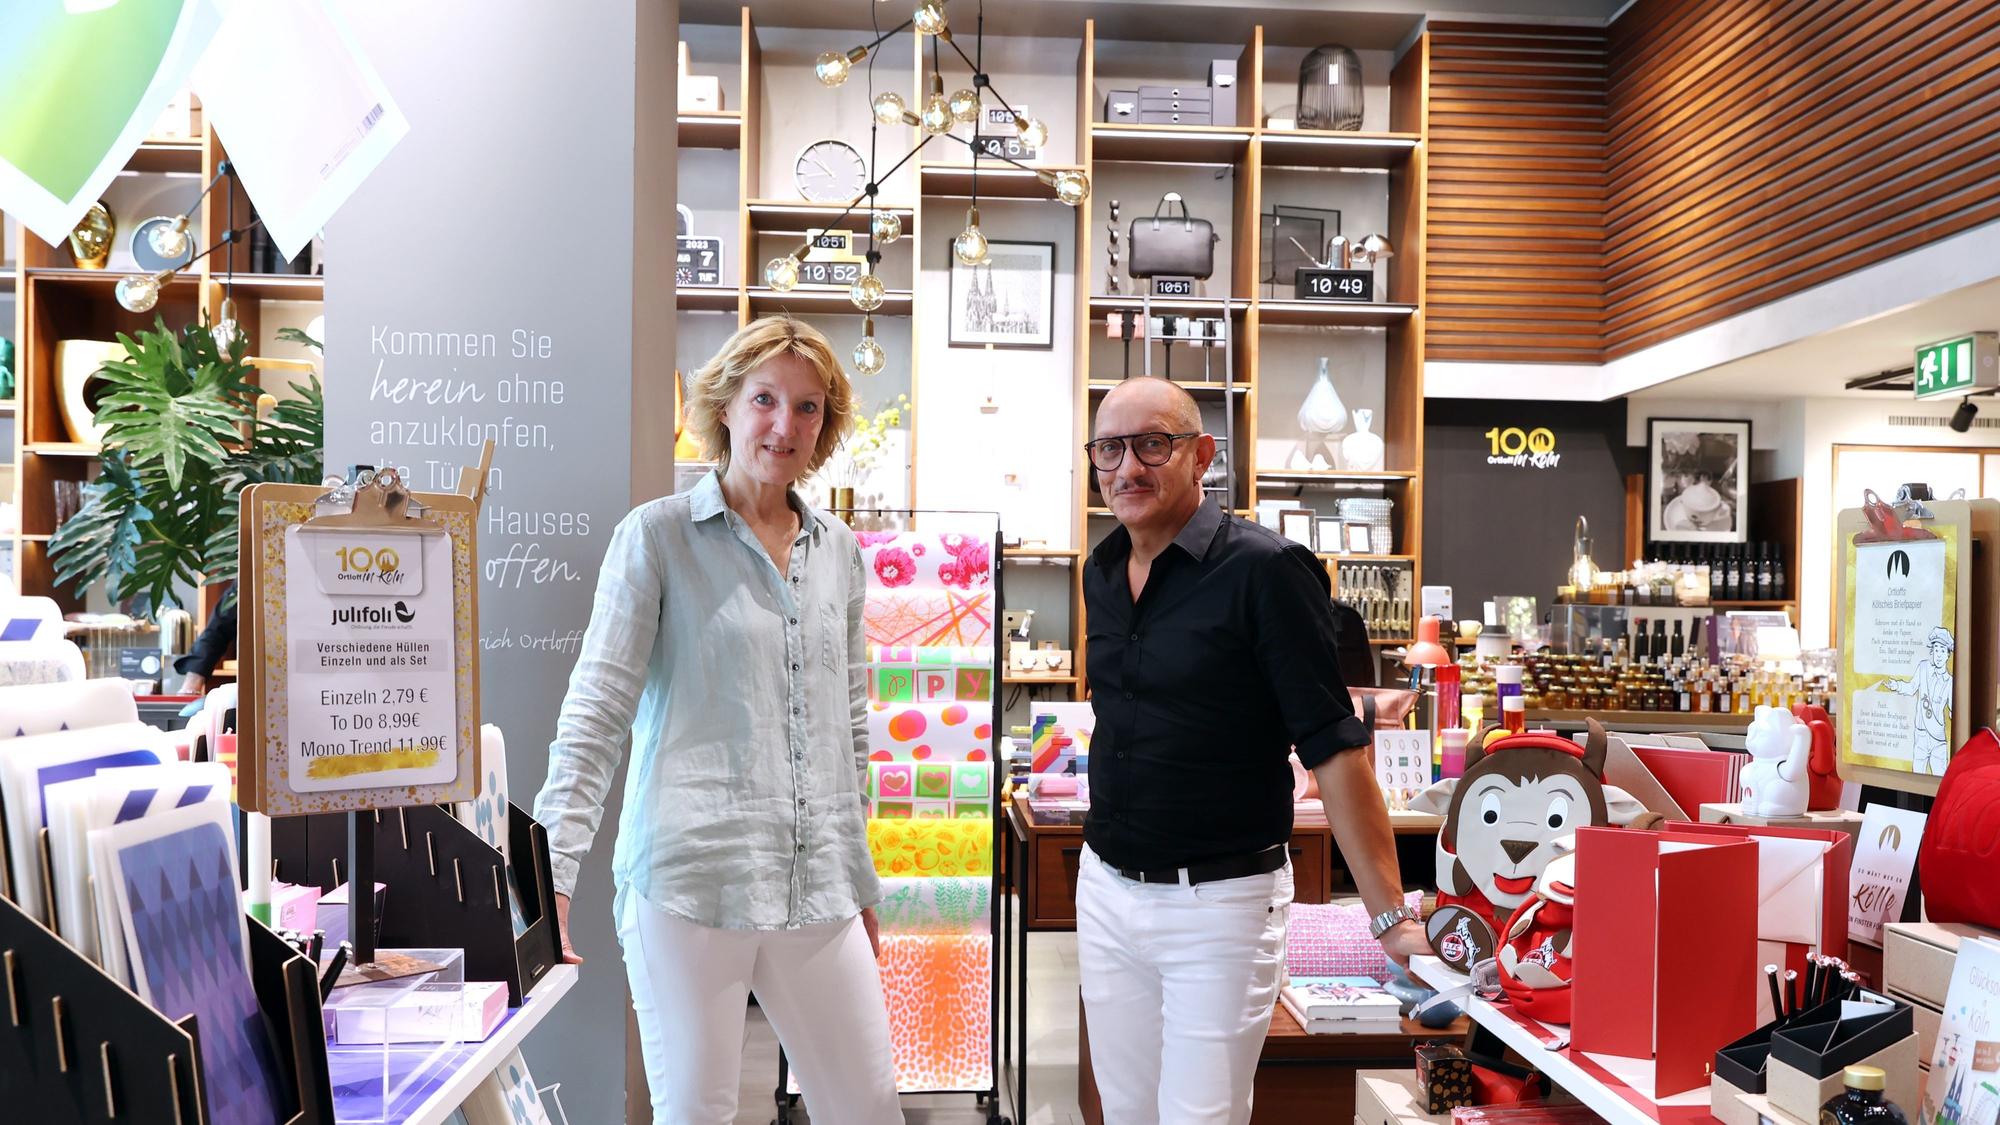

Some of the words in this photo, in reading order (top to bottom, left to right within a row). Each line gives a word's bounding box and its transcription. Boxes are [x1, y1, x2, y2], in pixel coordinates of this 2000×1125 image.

[686, 240, 709, 249] 2023
[700, 251, 714, 266] 7
[371, 325, 496, 357] Kommen
[511, 328, 552, 358] Sie
[369, 358, 486, 405] herein
[497, 373, 564, 404] ohne
[370, 415, 554, 451] anzuklopfen,
[1485, 427, 1555, 456] 100
[425, 460, 502, 491] Tün
[488, 506, 590, 536] Hauses
[335, 547, 400, 572] 100
[485, 543, 581, 588] offen.
[362, 569, 375, 583] in
[317, 642, 392, 653] Verschiedene
[396, 642, 430, 652] Hüllen
[519, 629, 583, 654] Ortloff
[321, 656, 362, 667] Einzeln
[366, 656, 386, 666] und
[391, 656, 406, 665] als
[410, 655, 427, 665] Set
[321, 689, 377, 706] Einzeln
[420, 688, 429, 703] €
[330, 715, 347, 730] To
[353, 714, 373, 730] Do
[301, 741, 345, 757] Mono
[350, 738, 392, 755] Trend
[1853, 884, 1897, 913] Kölle
